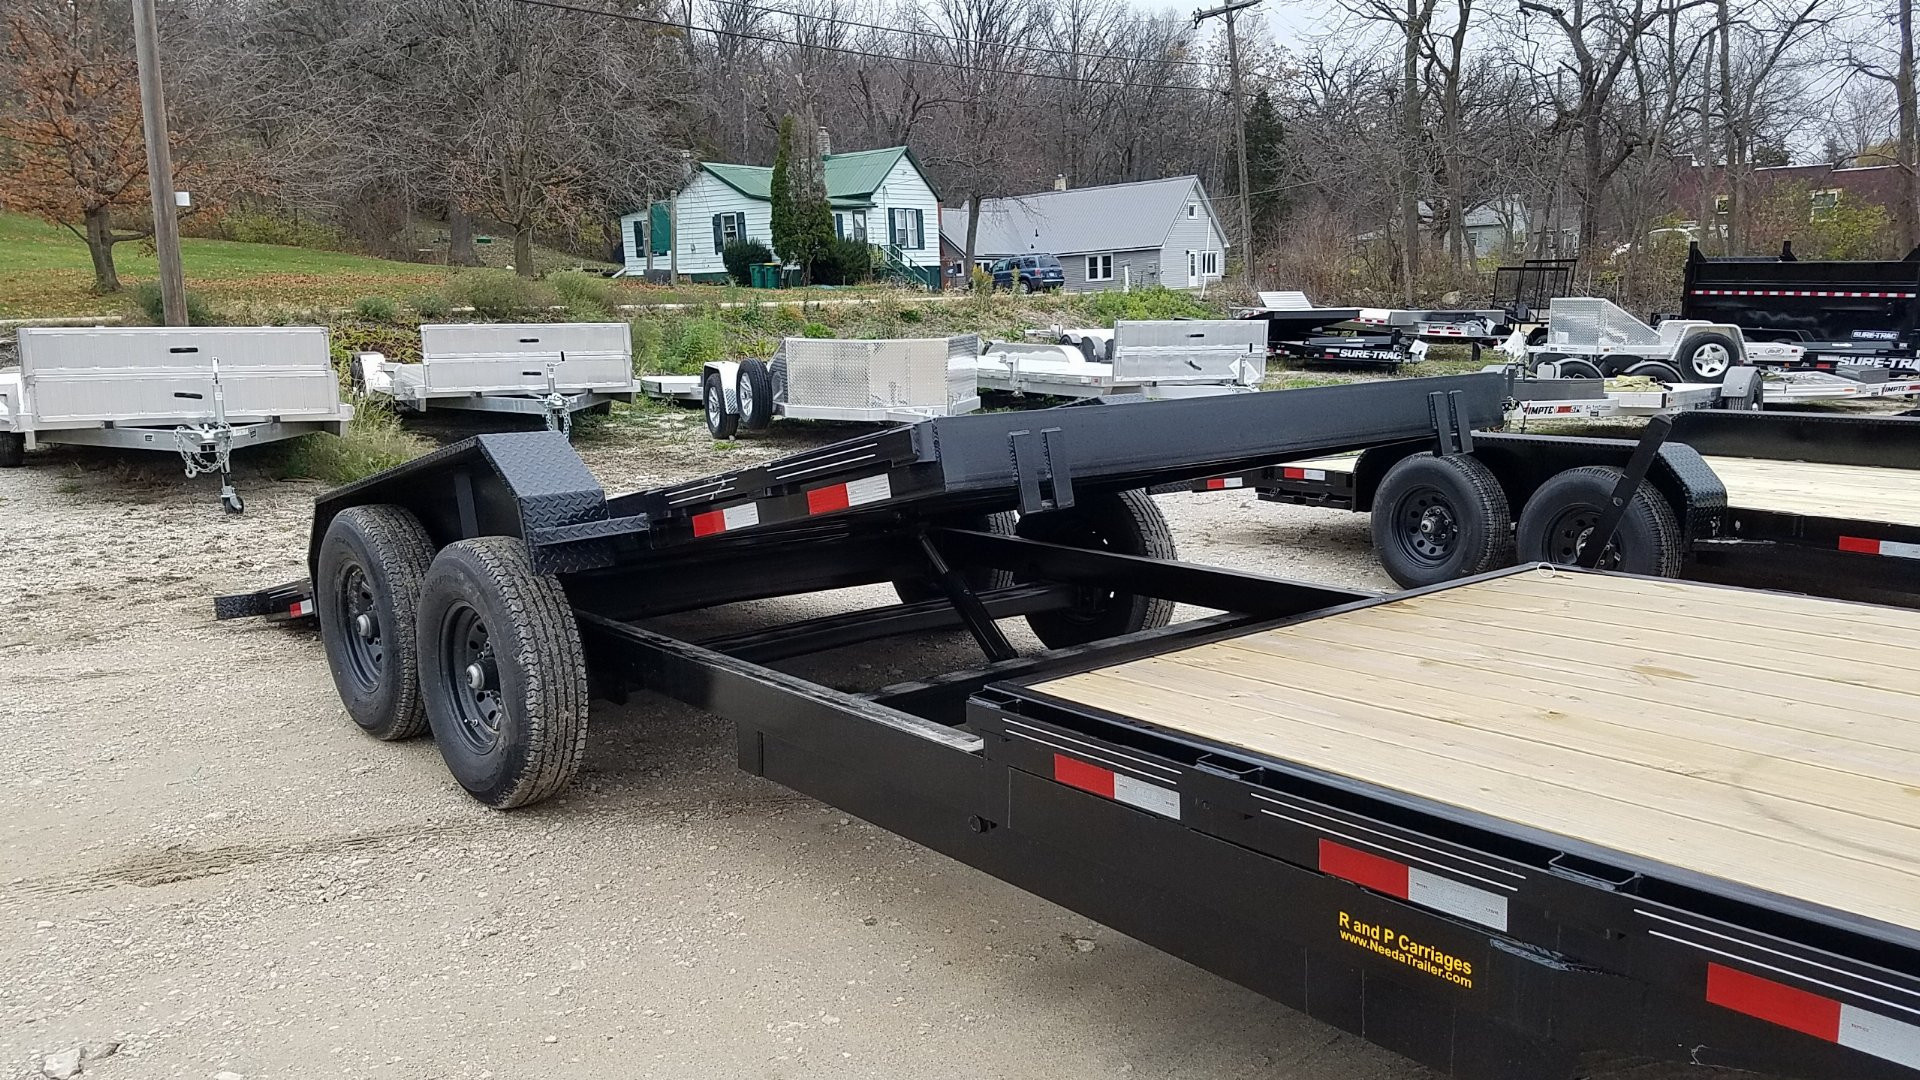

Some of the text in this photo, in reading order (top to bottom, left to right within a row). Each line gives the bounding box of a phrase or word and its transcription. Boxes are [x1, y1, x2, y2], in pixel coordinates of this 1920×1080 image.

[1853, 331, 1897, 340] SURE-TRAC
[1339, 349, 1402, 360] SURE-TRAC
[1339, 911, 1472, 975] R and P Carriages
[1340, 930, 1472, 989] www.NeedaTrailer.com
